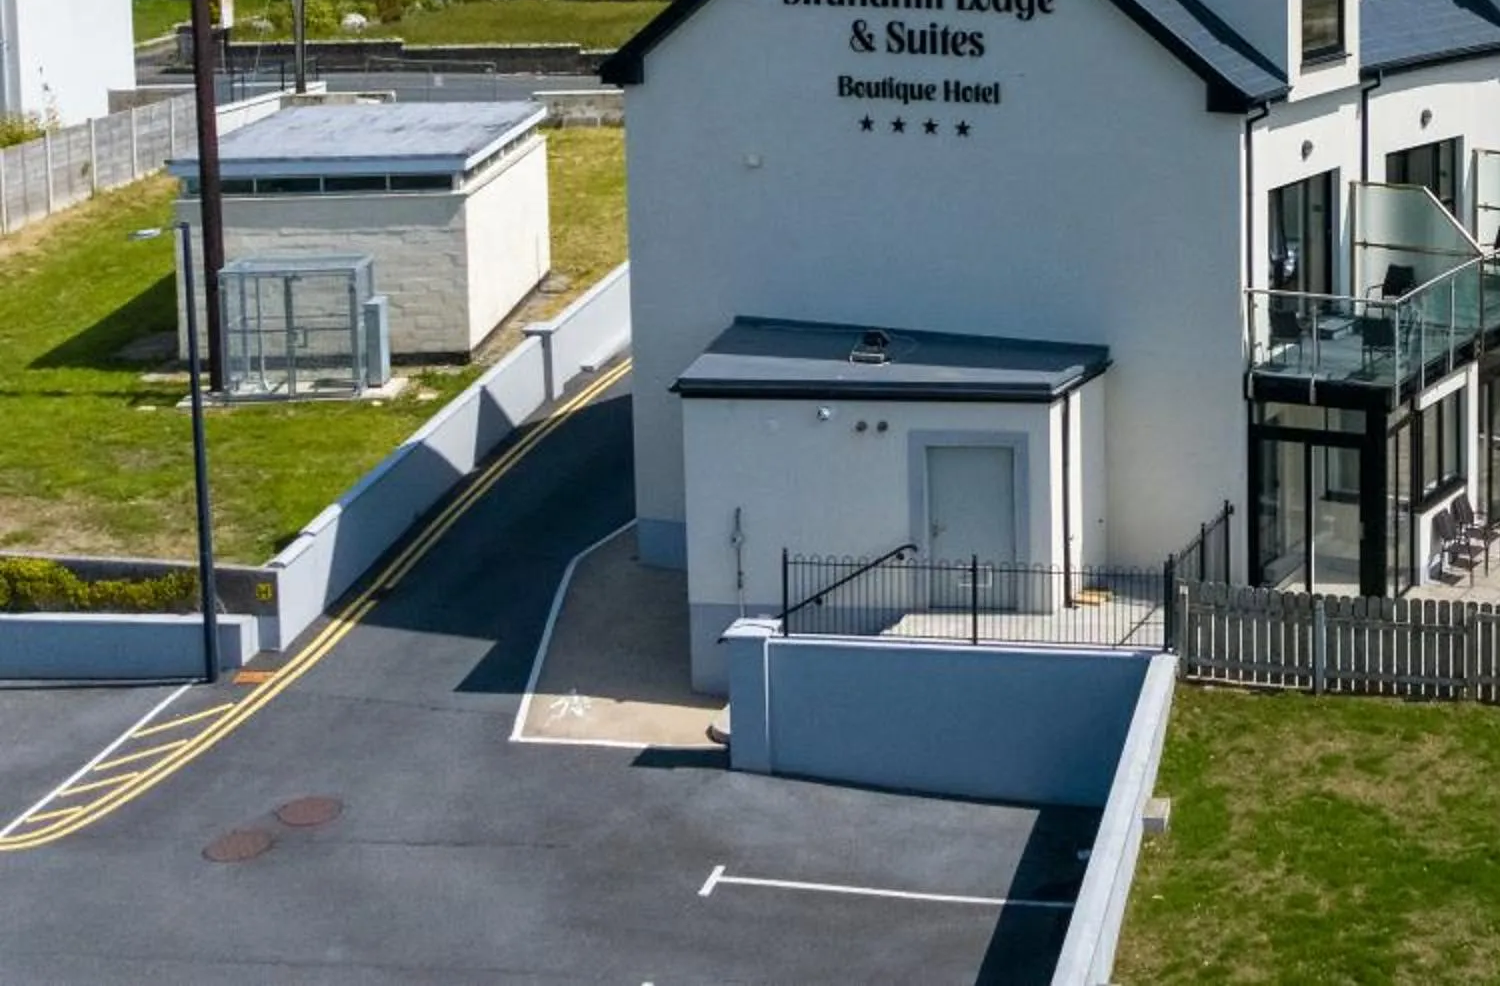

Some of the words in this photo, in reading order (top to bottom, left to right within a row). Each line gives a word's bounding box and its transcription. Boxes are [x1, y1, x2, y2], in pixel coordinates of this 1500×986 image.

[849, 19, 876, 52] &
[886, 20, 985, 57] Suites
[837, 75, 937, 105] Boutique
[943, 80, 1000, 104] Hotel
